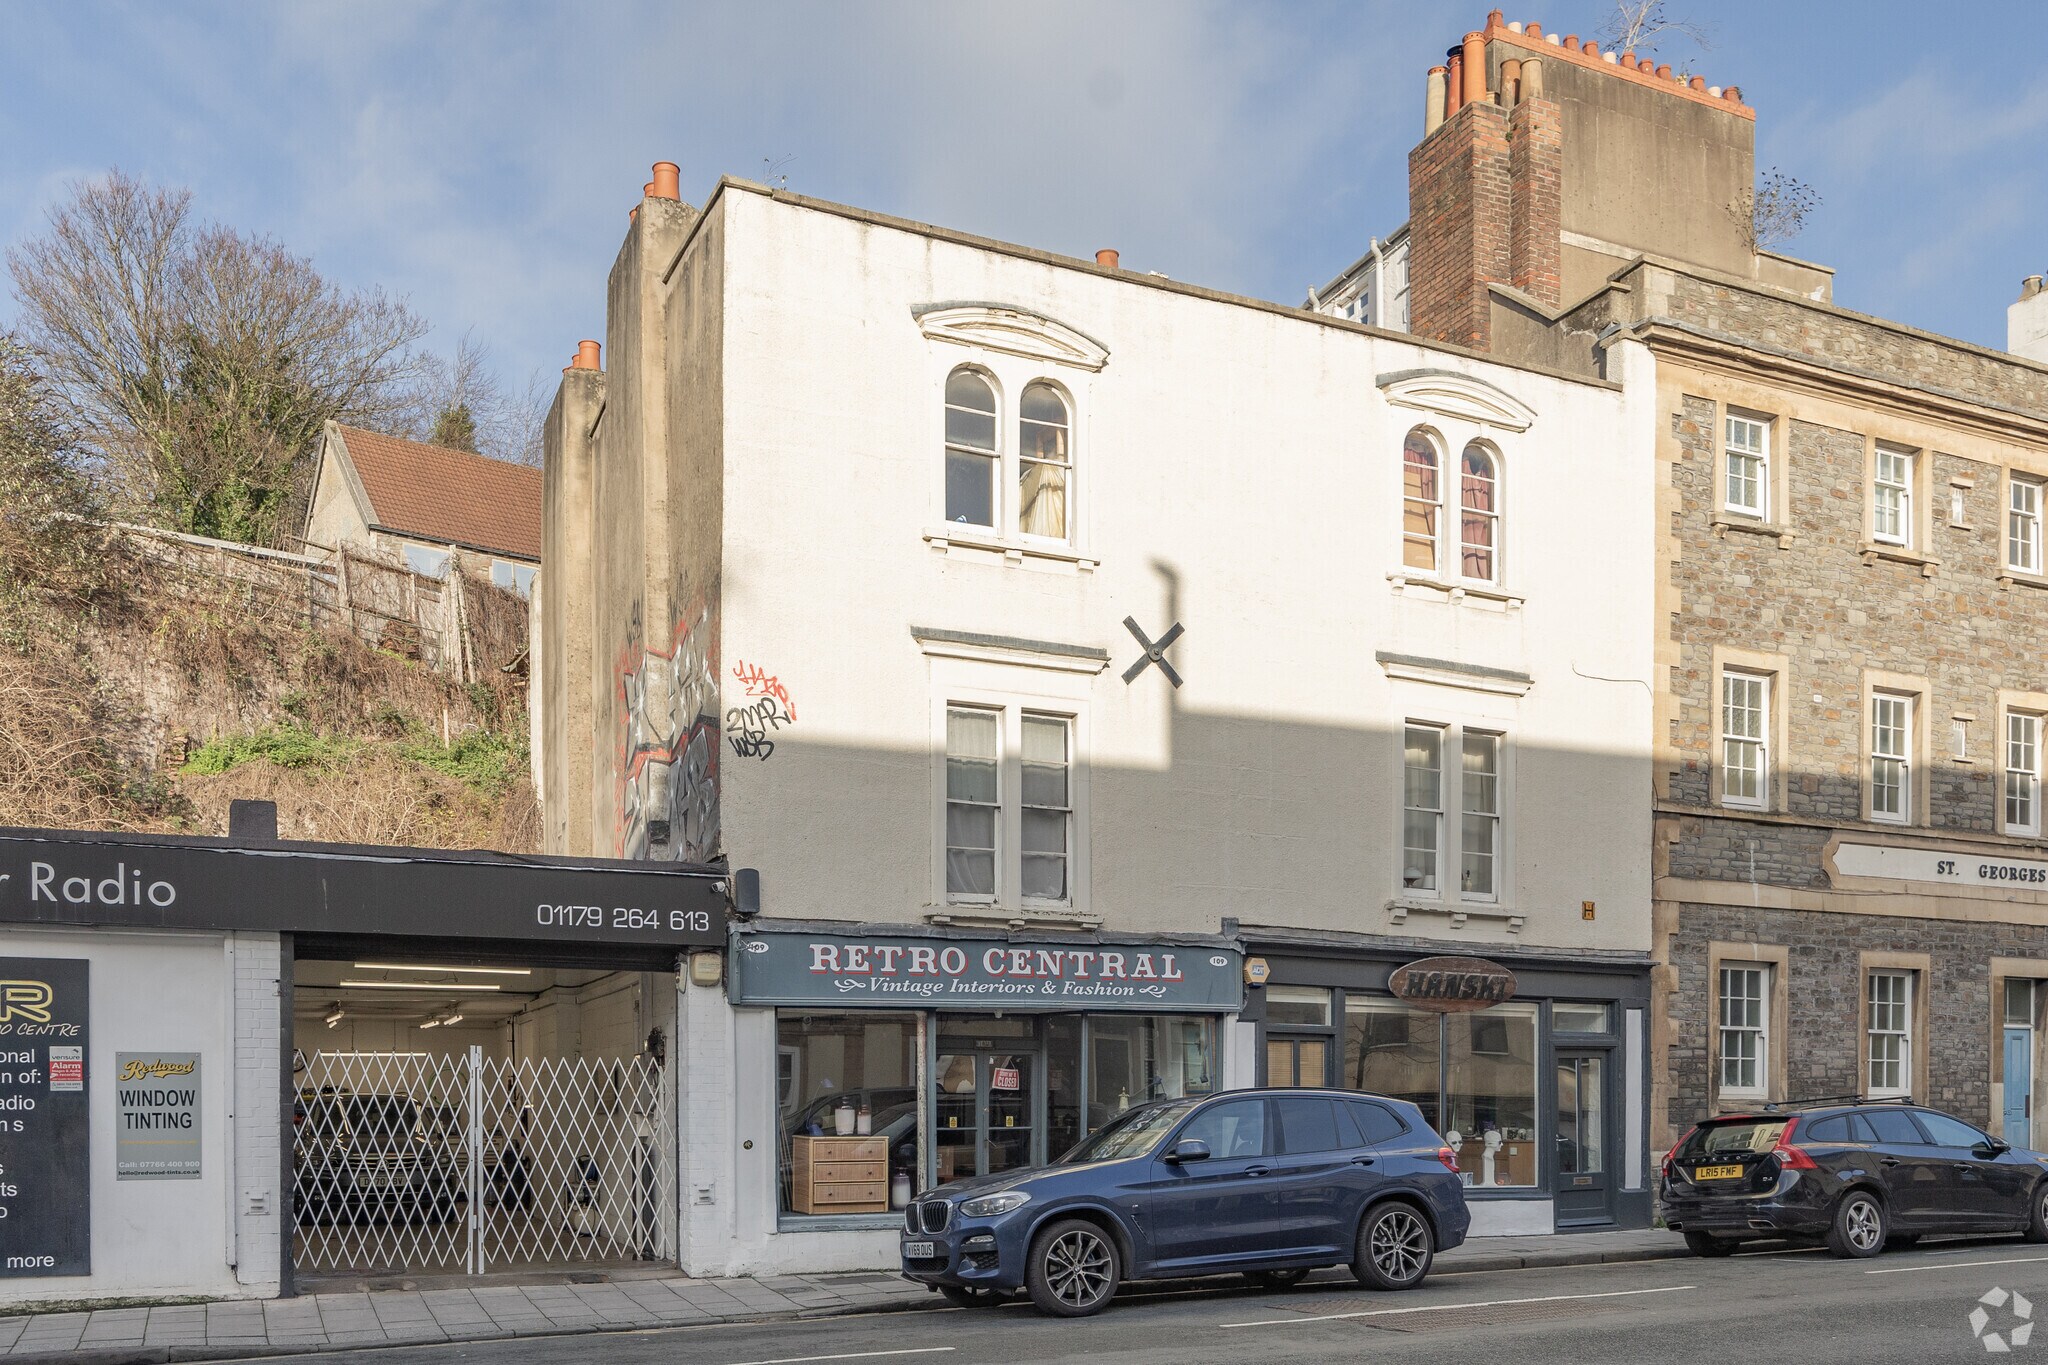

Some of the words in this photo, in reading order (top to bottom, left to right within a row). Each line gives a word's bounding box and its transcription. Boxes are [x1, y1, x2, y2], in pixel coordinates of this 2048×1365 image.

[1937, 860, 1959, 875] ST.
[1979, 864, 2046, 882] GEORGES
[31, 861, 177, 907] Radio
[537, 904, 603, 927] 01179
[612, 908, 660, 930] 264
[669, 910, 709, 932] 613
[808, 944, 970, 977] RETRO
[982, 948, 1185, 982] CENTRAL
[1212, 957, 1225, 966] 109
[869, 977, 944, 996] Vintage
[949, 979, 1036, 995] Interiors
[1040, 980, 1057, 995] &
[1061, 980, 1136, 996] Fashion
[17, 1022, 81, 1037] CENTRE
[19, 1069, 41, 1083] of:
[119, 1059, 195, 1081] Redwood
[998, 1076, 1017, 1088] CLOSED
[120, 1090, 195, 1107] WINDOW
[124, 1112, 192, 1129] TINTING
[1700, 1168, 1718, 1178] LR15
[1720, 1166, 1737, 1176] FMF
[7, 1256, 55, 1268] more
